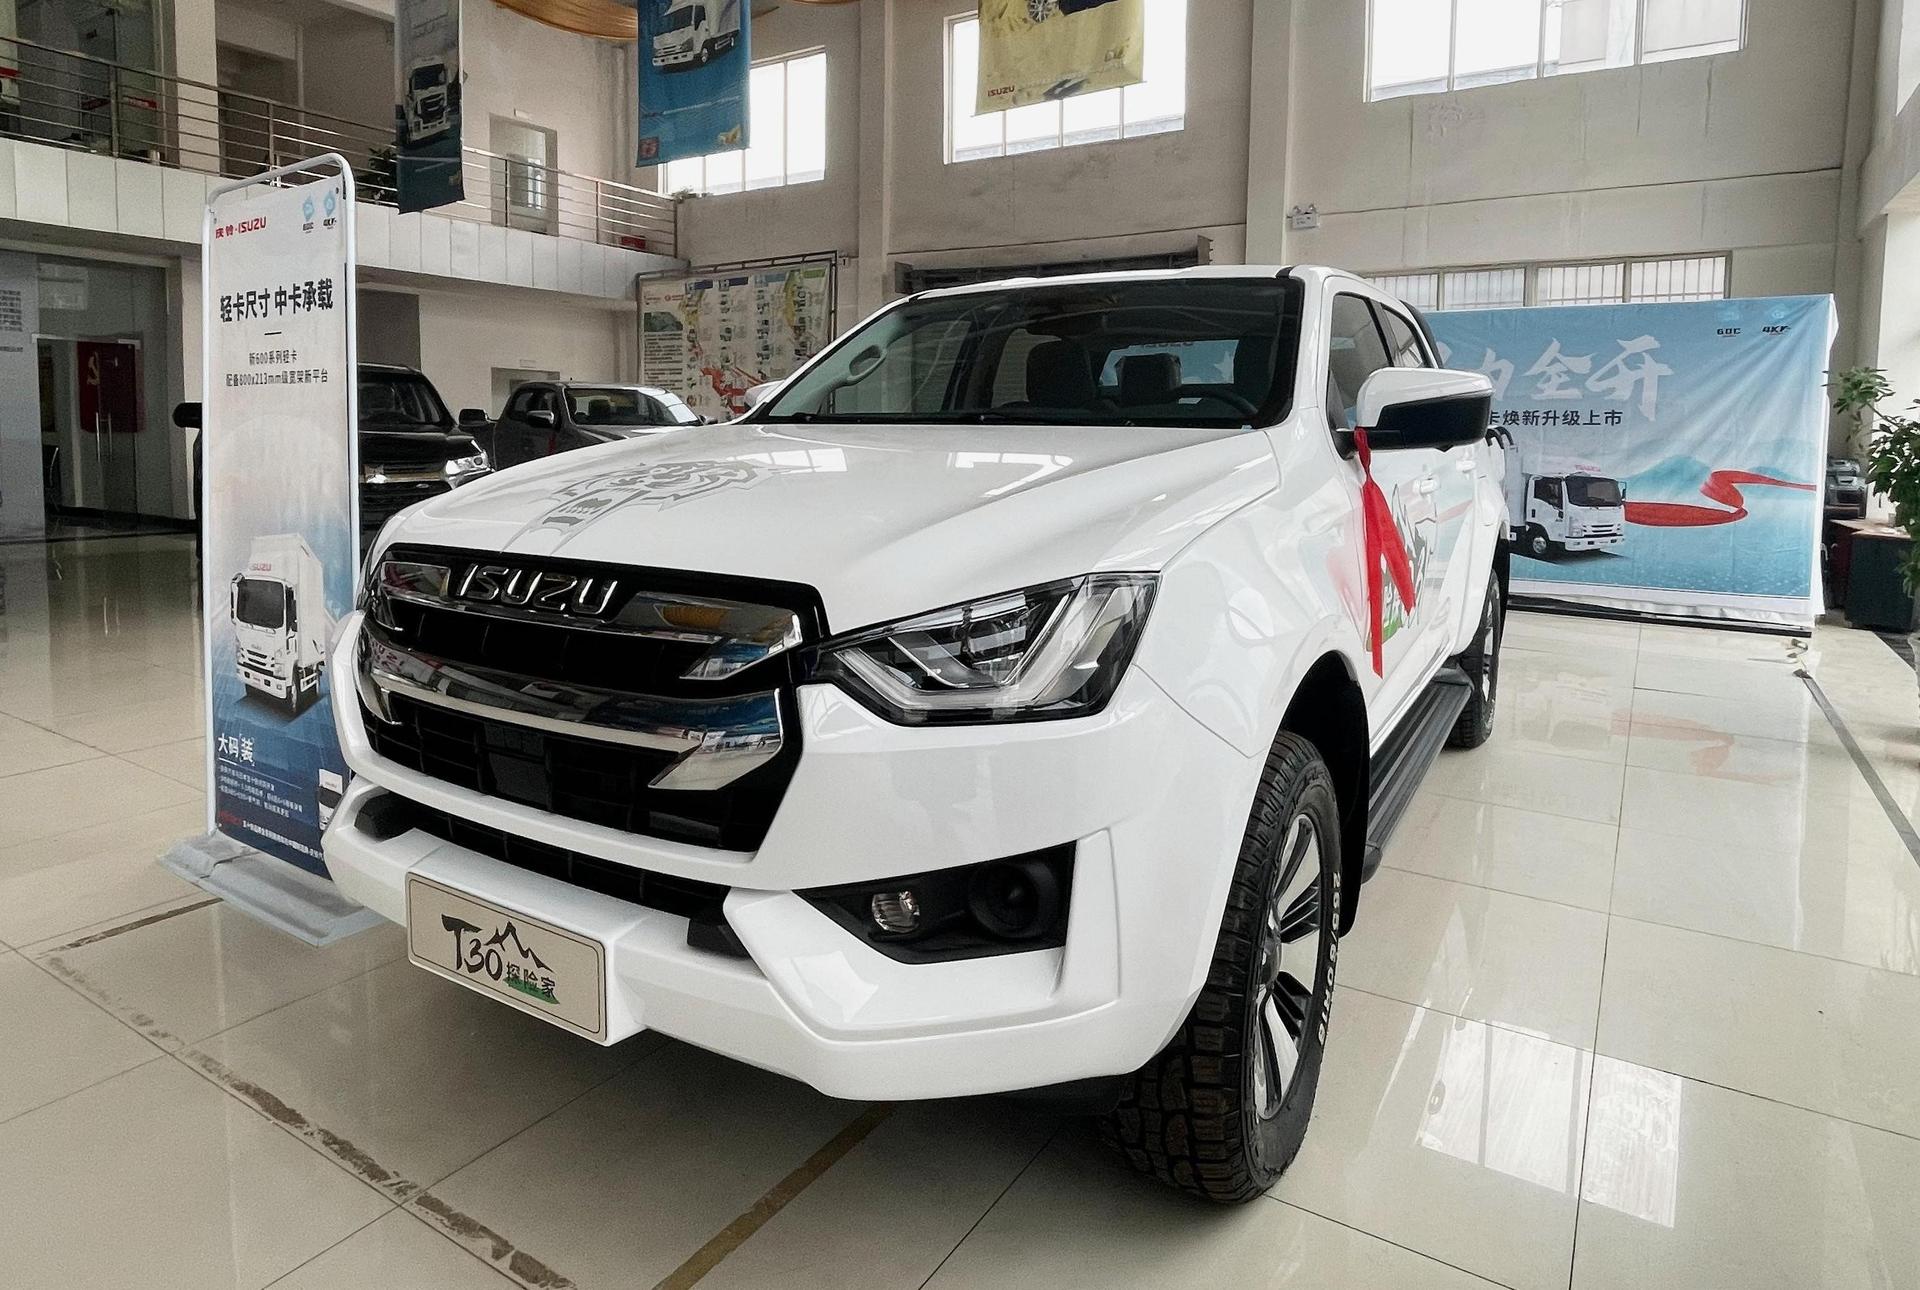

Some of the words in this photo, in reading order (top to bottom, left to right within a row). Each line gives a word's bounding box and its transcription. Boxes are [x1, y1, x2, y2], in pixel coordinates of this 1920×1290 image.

[987, 85, 1015, 97] ISUZU
[220, 287, 271, 323] 轻卡尺寸
[274, 277, 333, 316] 中卡承载
[456, 563, 618, 615] ISUZU
[441, 913, 503, 981] T30
[506, 961, 557, 998] 探险家
